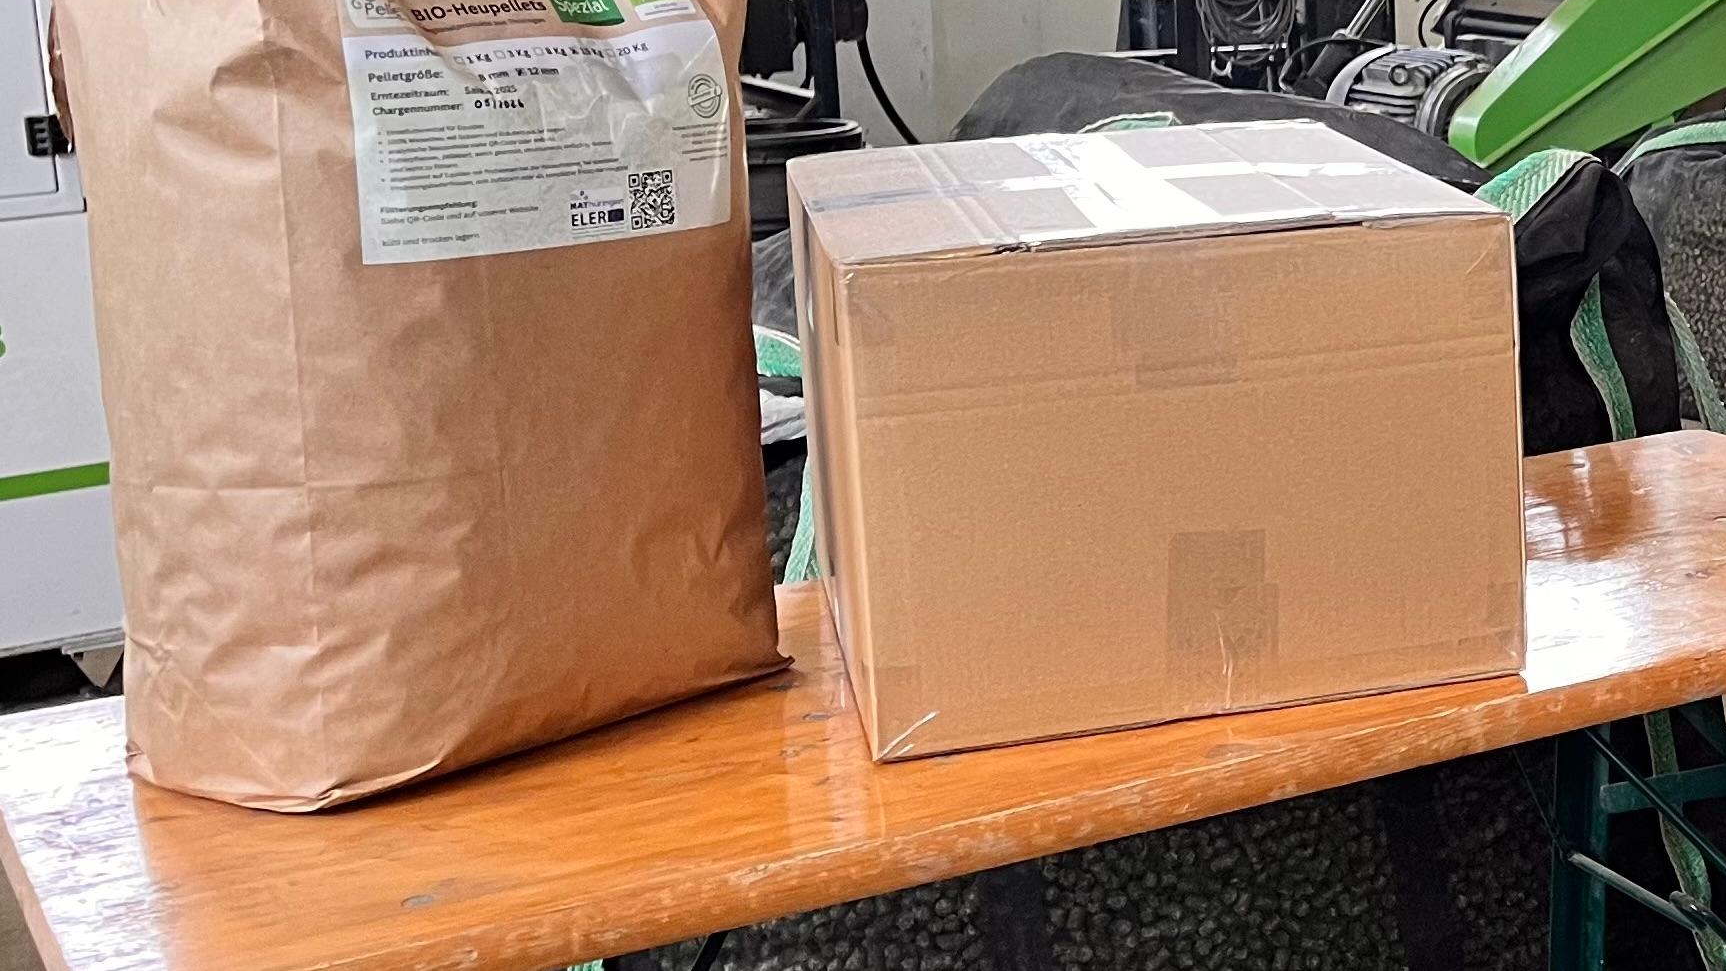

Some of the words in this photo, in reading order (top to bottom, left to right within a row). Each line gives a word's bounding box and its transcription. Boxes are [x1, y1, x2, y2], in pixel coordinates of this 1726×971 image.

[410, 0, 547, 22] BIO-Heupellets
[364, 46, 440, 60] Produktinh
[616, 47, 631, 57] 20
[367, 69, 445, 83] Pelletgröße:
[571, 210, 607, 227] ELER
